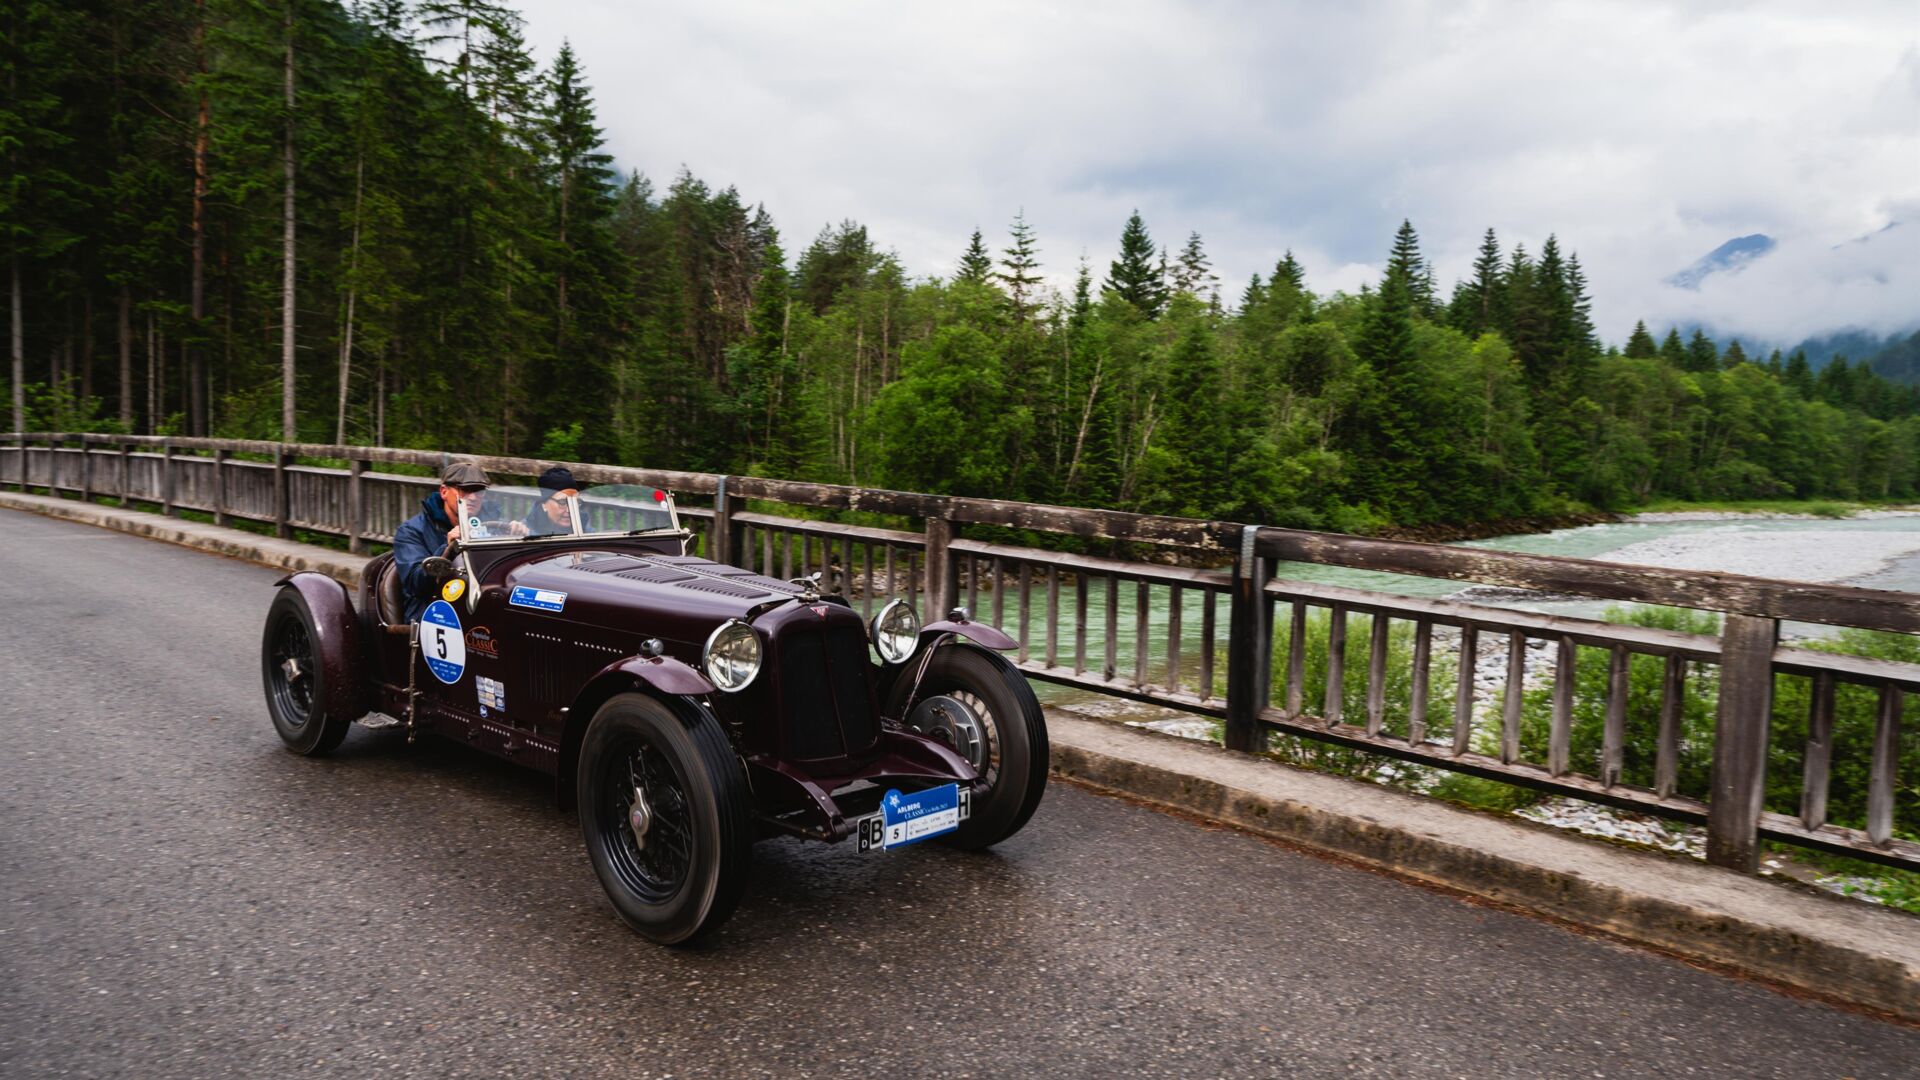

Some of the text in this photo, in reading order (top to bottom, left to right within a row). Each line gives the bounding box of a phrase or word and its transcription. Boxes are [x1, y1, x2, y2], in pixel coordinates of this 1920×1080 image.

[436, 628, 447, 660] 5
[465, 632, 498, 653] CLASSIC
[897, 802, 921, 814] ARLBERG
[904, 808, 925, 820] CLASSIC
[871, 820, 884, 846] B
[958, 793, 969, 819] H
[893, 828, 899, 839] 5
[861, 840, 868, 848] D
